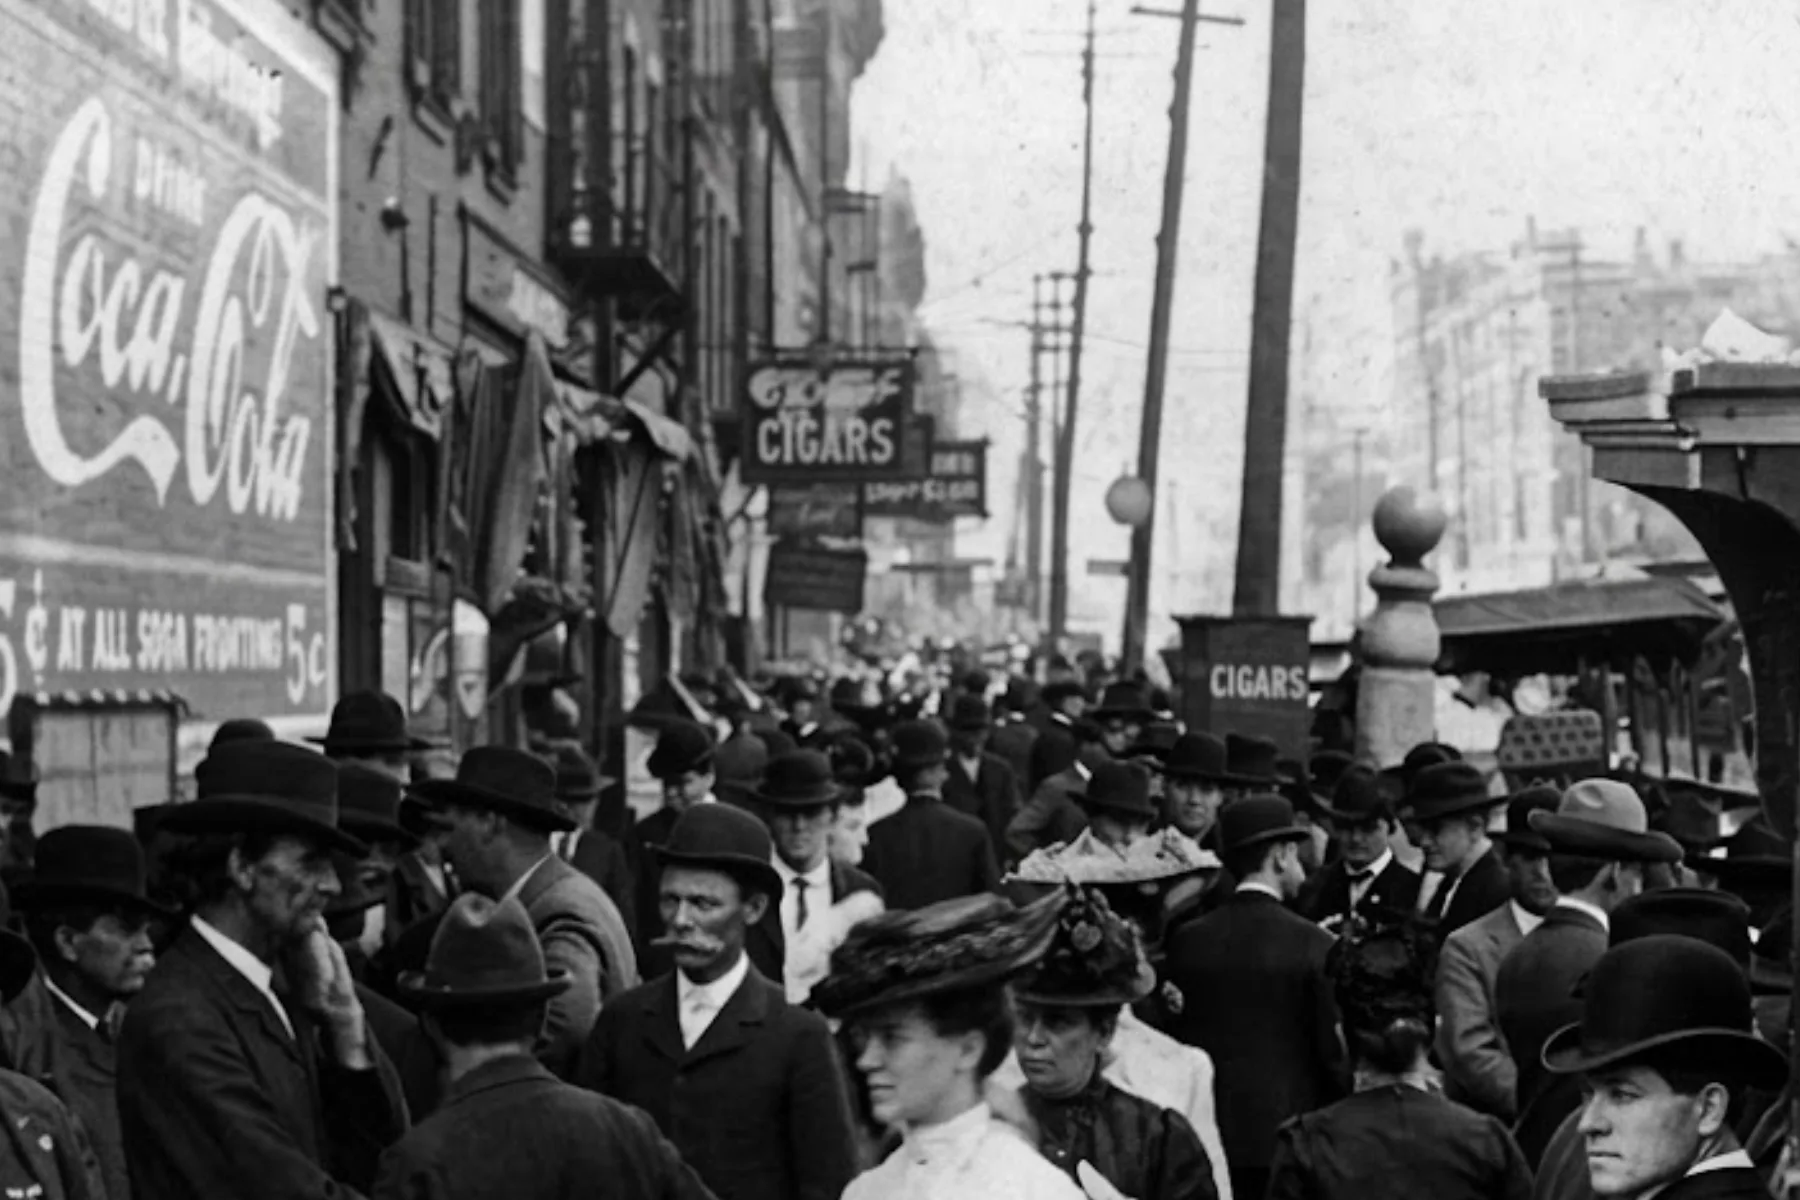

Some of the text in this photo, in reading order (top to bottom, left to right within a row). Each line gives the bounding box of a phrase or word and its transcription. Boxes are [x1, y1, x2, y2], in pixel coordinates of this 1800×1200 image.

[757, 416, 895, 465] CIGARS
[57, 607, 86, 671] AT
[92, 608, 131, 670] ALL
[1209, 663, 1307, 699] CIGARS
